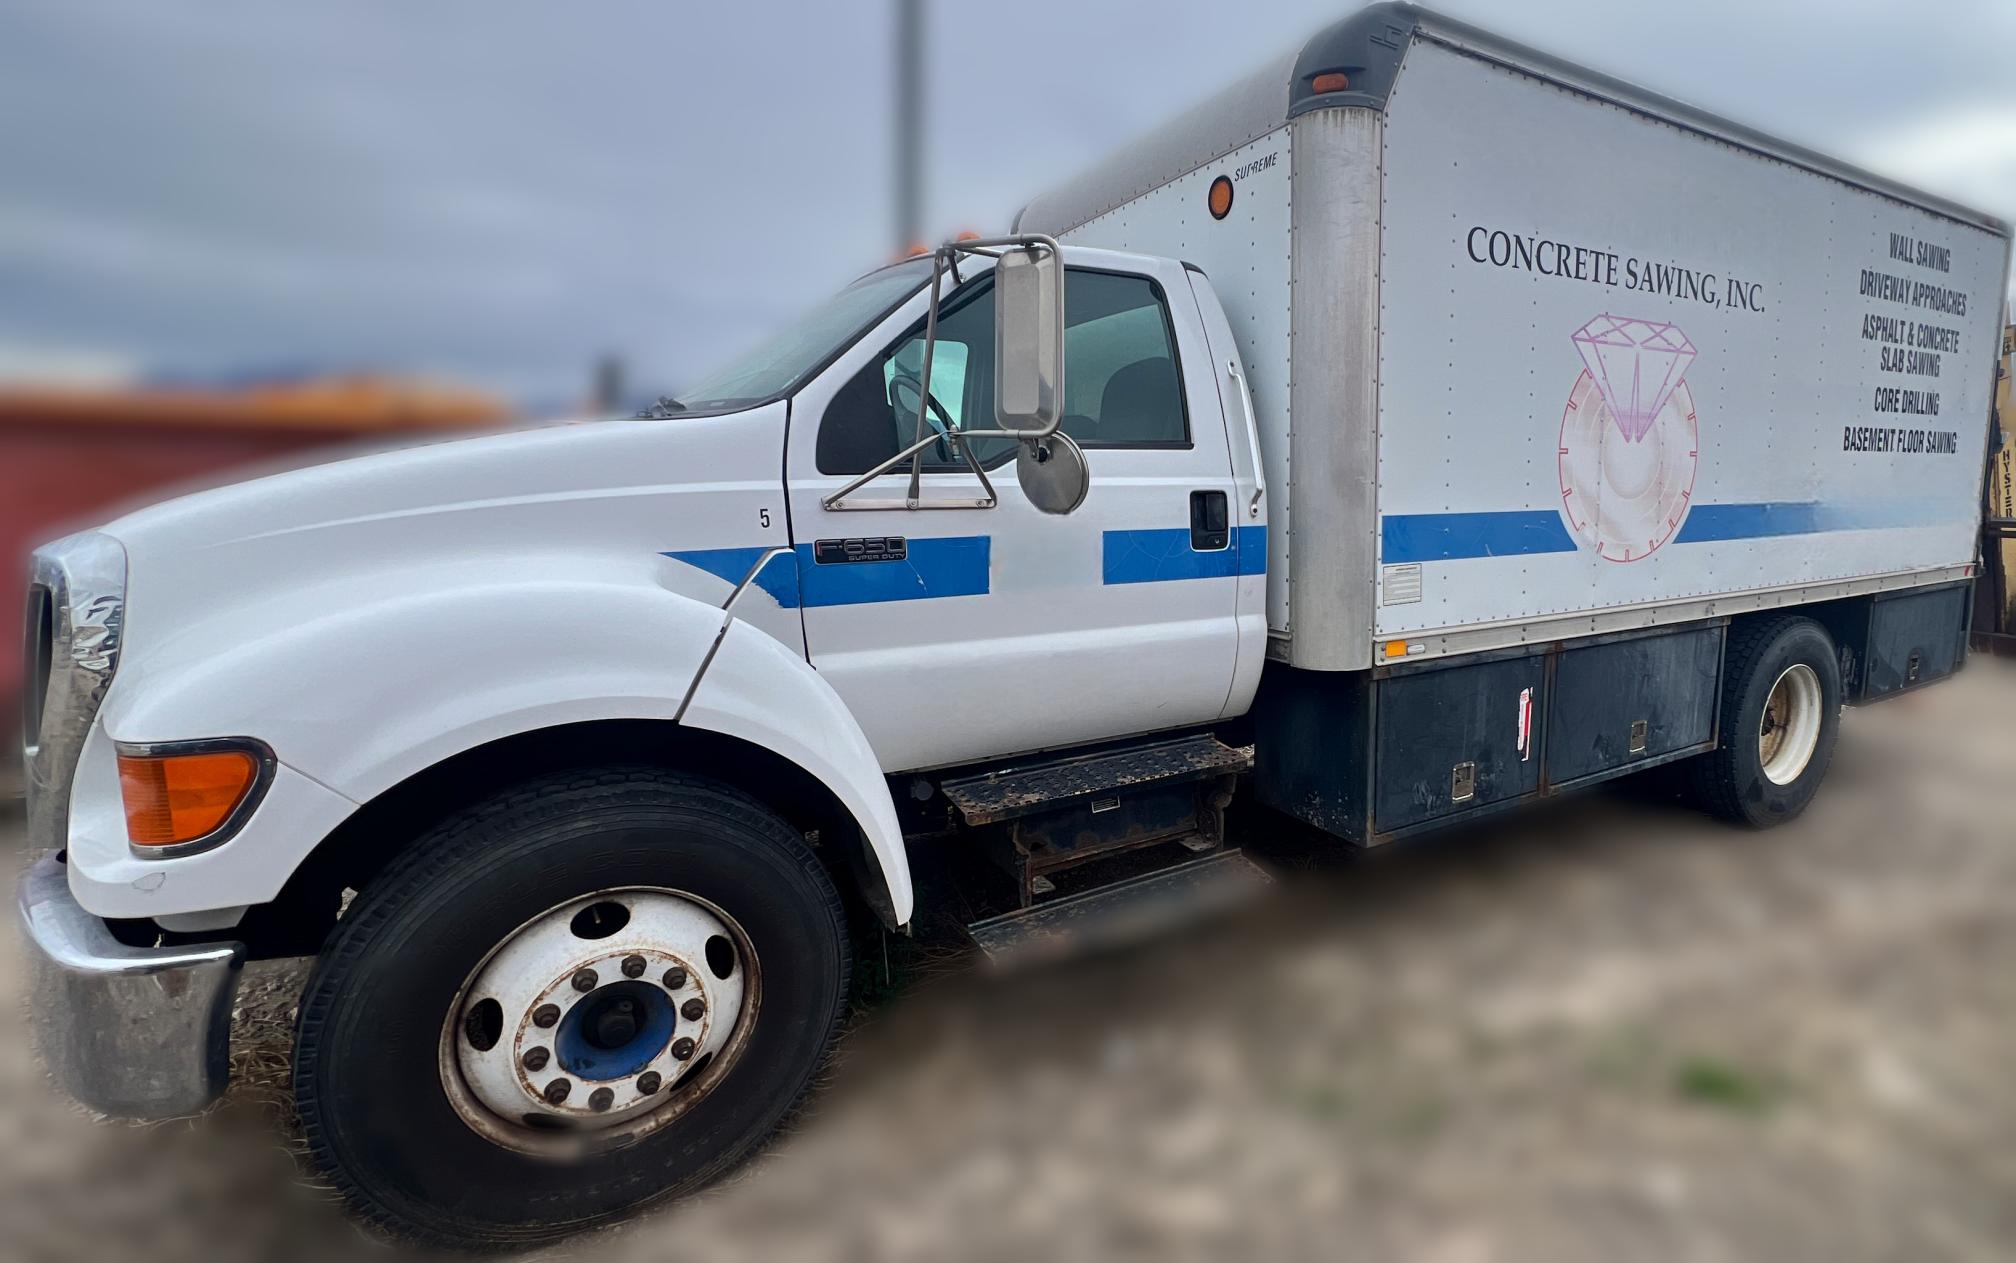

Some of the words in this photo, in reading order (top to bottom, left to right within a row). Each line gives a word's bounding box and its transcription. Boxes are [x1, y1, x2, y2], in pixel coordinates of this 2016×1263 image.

[1466, 226, 1619, 287] CONCRETE
[1625, 257, 1722, 309] SAWING,
[1726, 278, 1765, 312] INC.
[1889, 231, 1914, 264] WALL
[1916, 240, 1951, 273] SAWING
[1860, 269, 1912, 305] DRIVEWAY
[1911, 281, 1967, 317] APPROACHES
[1861, 313, 1906, 345] ASPHALT
[1907, 321, 1915, 346] &
[1917, 323, 1960, 354] CONCRETE
[1880, 345, 1905, 373] SLAB
[1906, 349, 1941, 378] SAWING
[1874, 386, 1900, 413] CORE
[1901, 389, 1940, 416] DRILLING
[1843, 426, 1896, 453] BASEMENT
[1896, 429, 1925, 454] FLOOR
[1925, 430, 1958, 454] SAWING
[2003, 450, 2013, 518] HYSTER
[759, 508, 771, 528] 5
[848, 553, 880, 561] SUPER
[881, 552, 905, 560] DUTY
